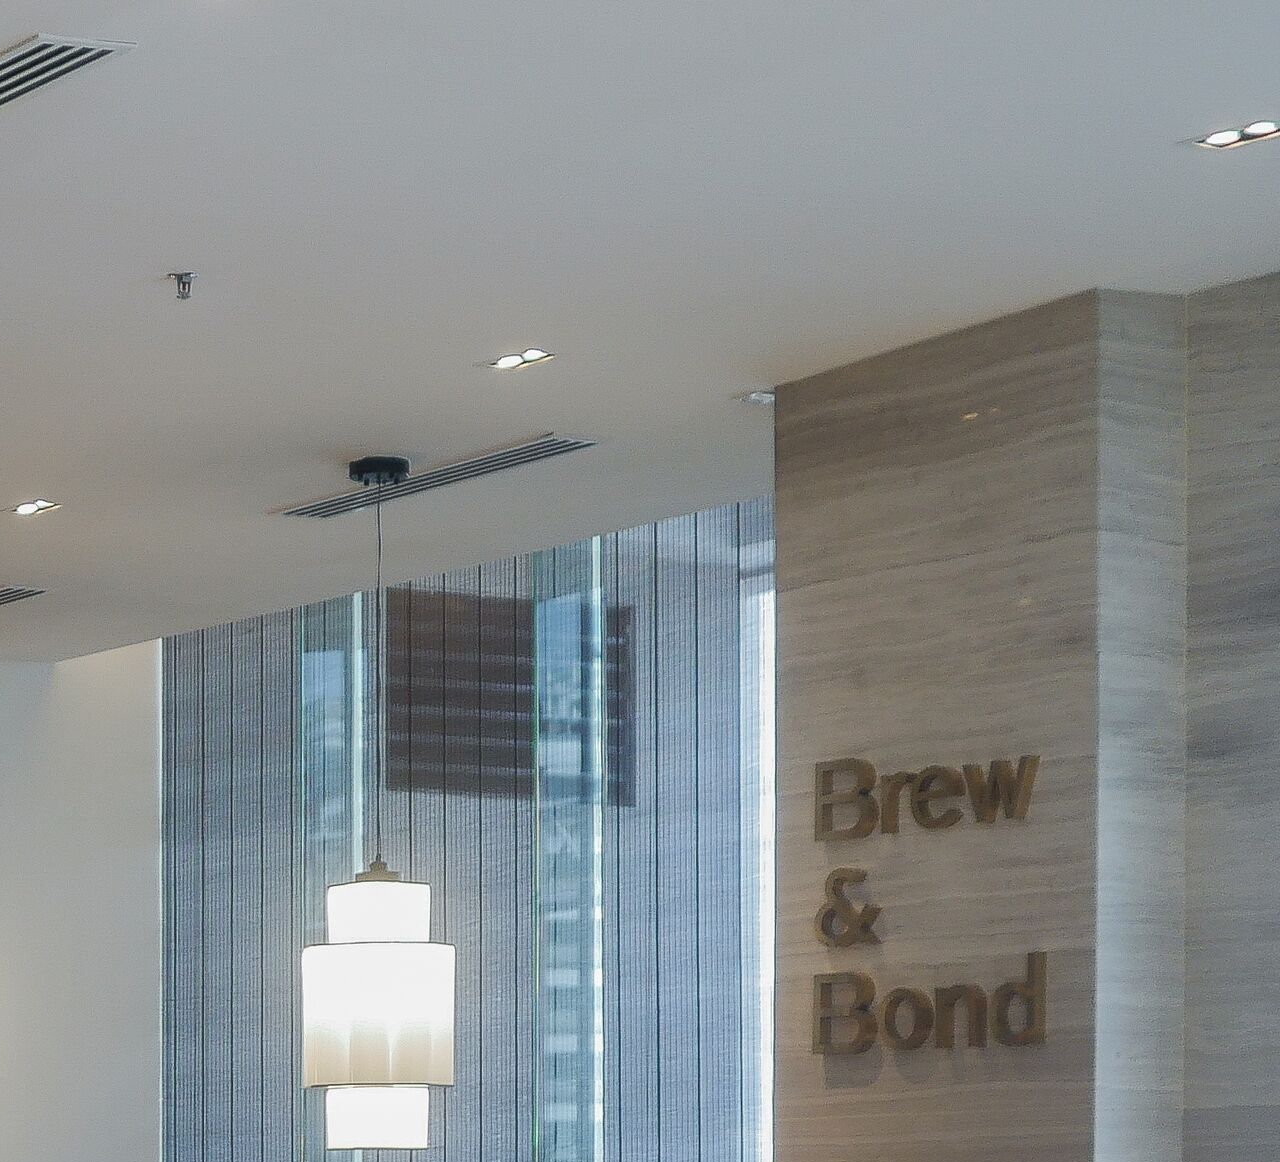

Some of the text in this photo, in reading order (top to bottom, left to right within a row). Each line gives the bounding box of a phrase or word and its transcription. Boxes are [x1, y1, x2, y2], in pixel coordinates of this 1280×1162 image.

[814, 755, 1041, 841] Brew
[815, 866, 883, 947] &
[812, 951, 1047, 1055] Bond
